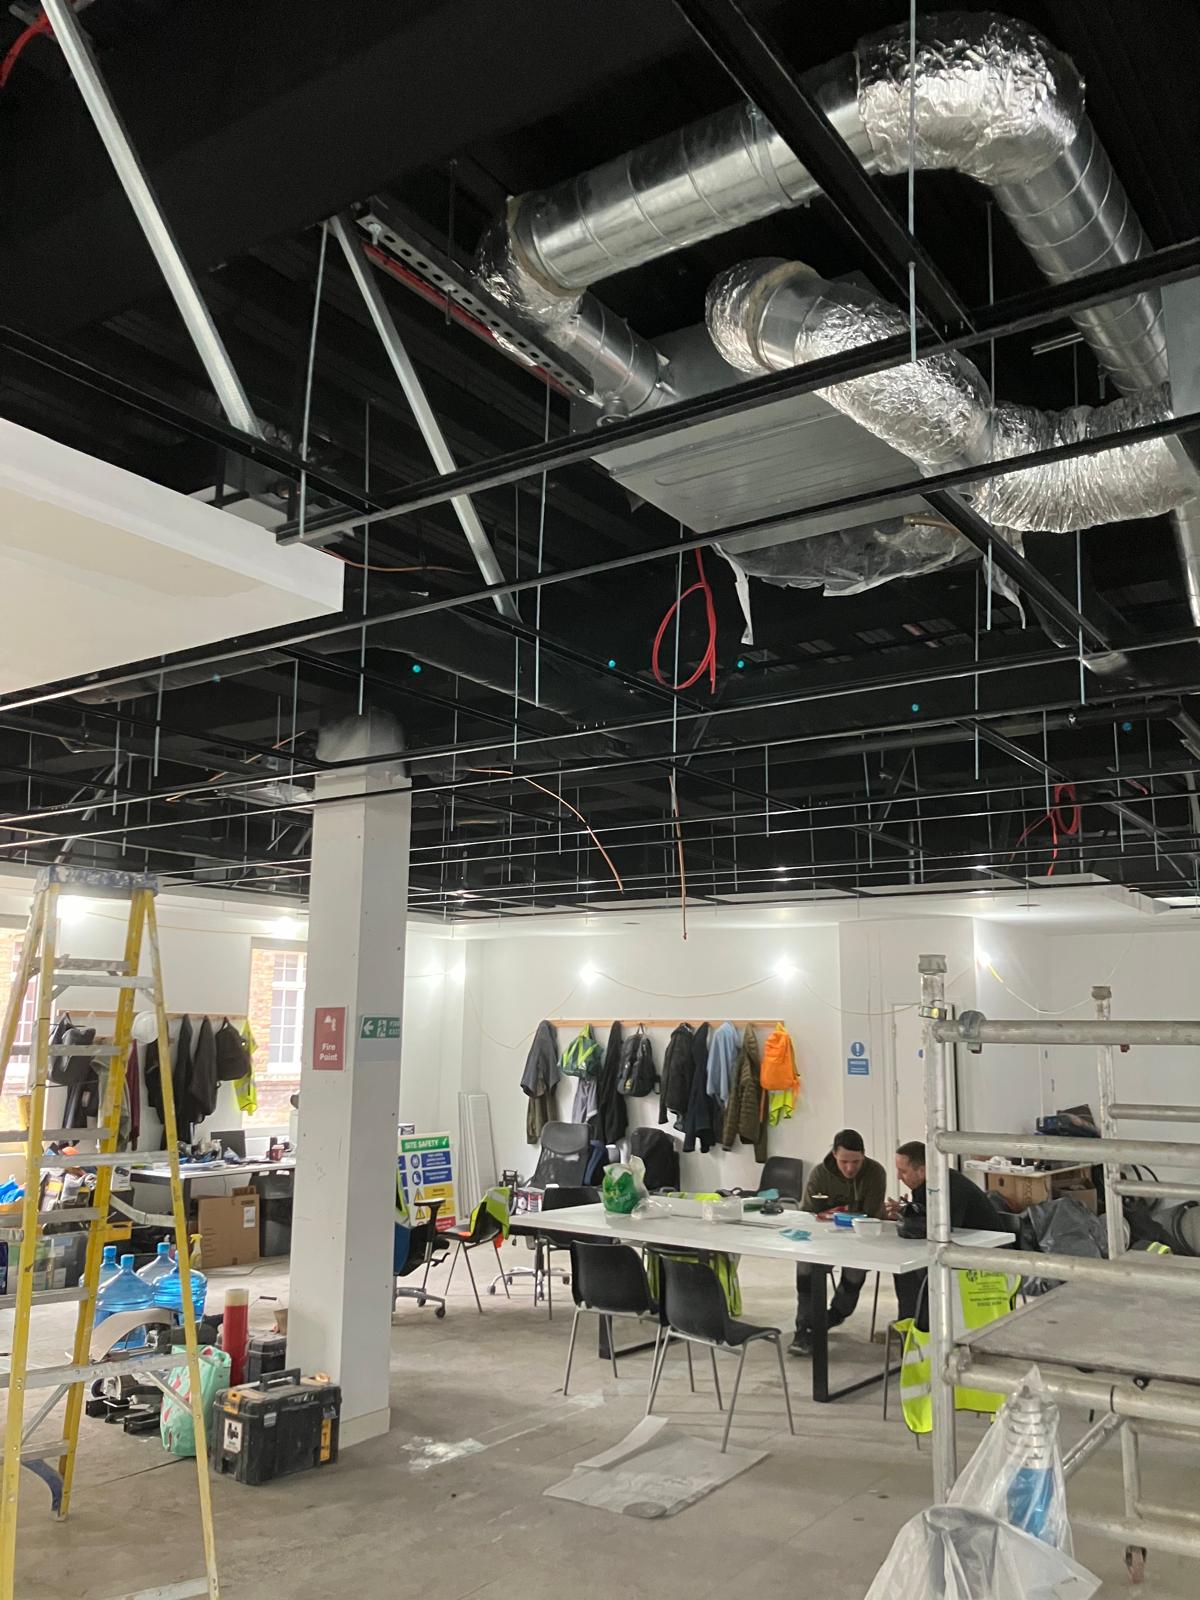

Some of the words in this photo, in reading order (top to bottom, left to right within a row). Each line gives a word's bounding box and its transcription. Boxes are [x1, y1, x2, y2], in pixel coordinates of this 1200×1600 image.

[322, 1043, 336, 1051] Fire
[319, 1053, 338, 1061] Point
[404, 1141, 417, 1150] SITE
[418, 1139, 439, 1149] SAFETY
